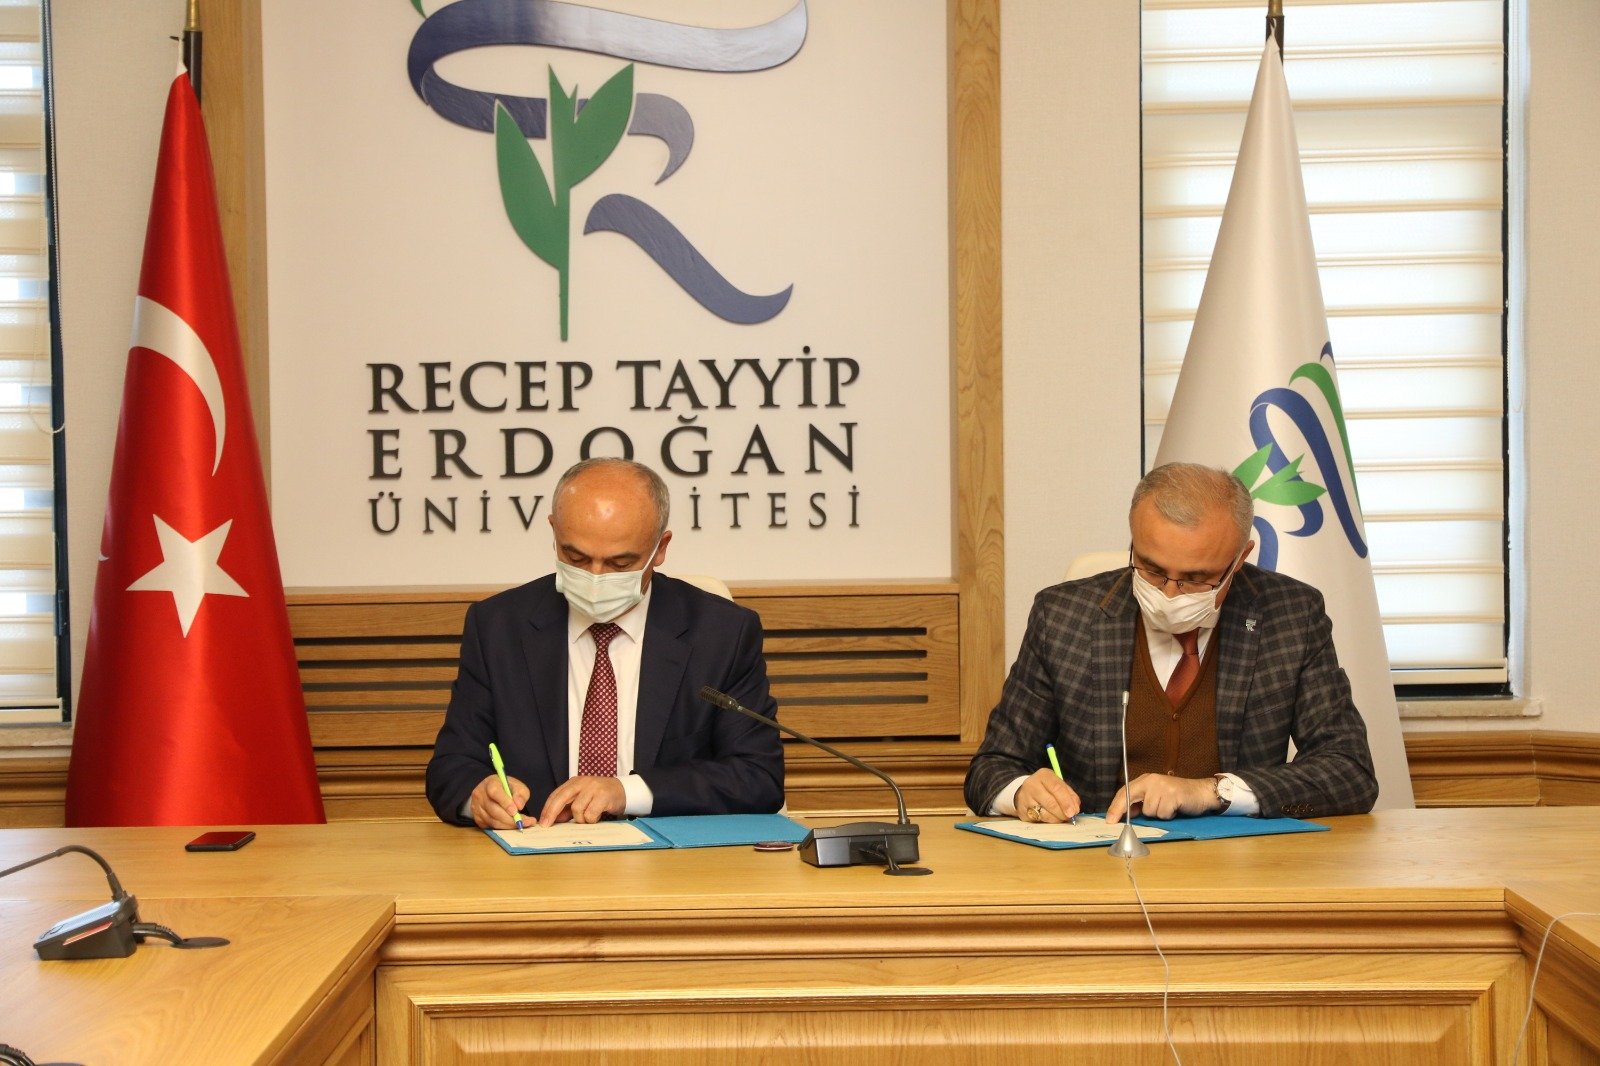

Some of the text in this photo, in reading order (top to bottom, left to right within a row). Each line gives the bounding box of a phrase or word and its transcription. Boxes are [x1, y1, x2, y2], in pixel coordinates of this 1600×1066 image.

[365, 345, 861, 415] RECEP TAYYİP
[366, 414, 859, 481] ERDOĞAN
[367, 484, 861, 536] ÜNİVİTESİ
